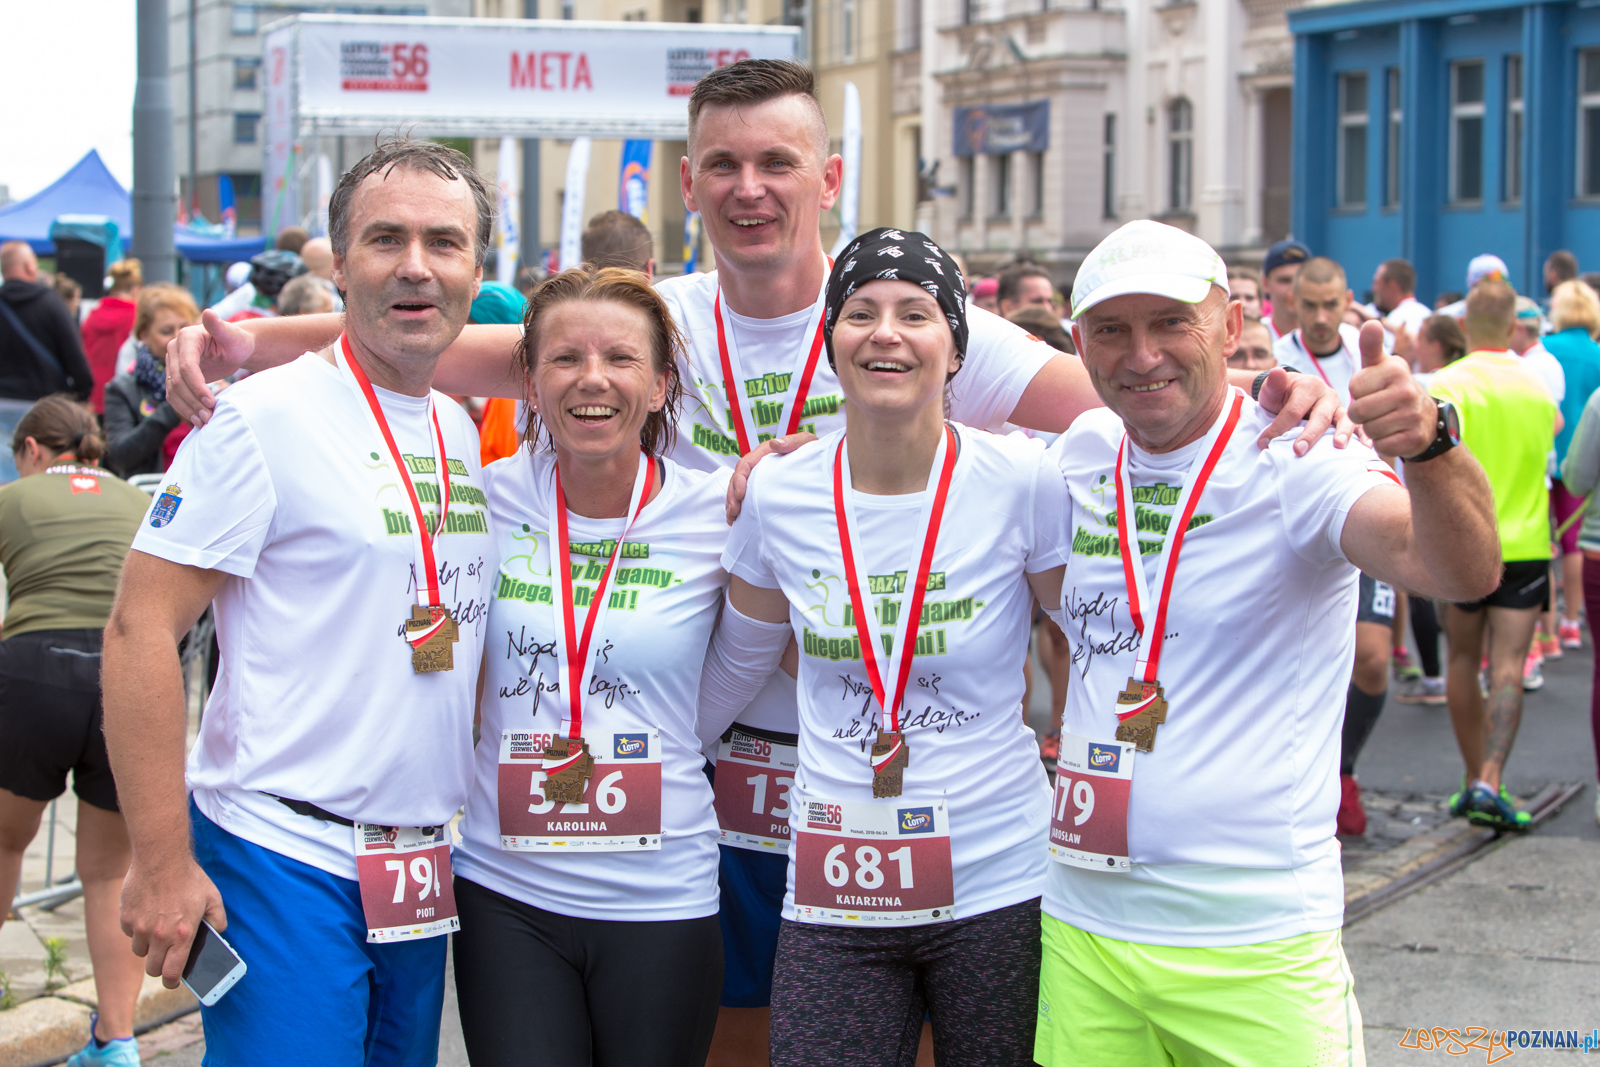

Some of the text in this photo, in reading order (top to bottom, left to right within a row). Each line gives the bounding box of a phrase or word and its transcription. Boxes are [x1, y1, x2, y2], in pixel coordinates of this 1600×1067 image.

[509, 51, 594, 91] META
[1064, 587, 1119, 640] Nigdy
[917, 673, 942, 695] się
[511, 733, 529, 741] LOTTO
[622, 742, 640, 752] LOTTO
[1095, 754, 1111, 764] LOTTO
[809, 802, 823, 811] LOTTO
[547, 821, 607, 832] KAROLINA
[907, 816, 925, 828] LOTTO
[823, 843, 914, 890] 681
[836, 894, 903, 907] KATARZYNA
